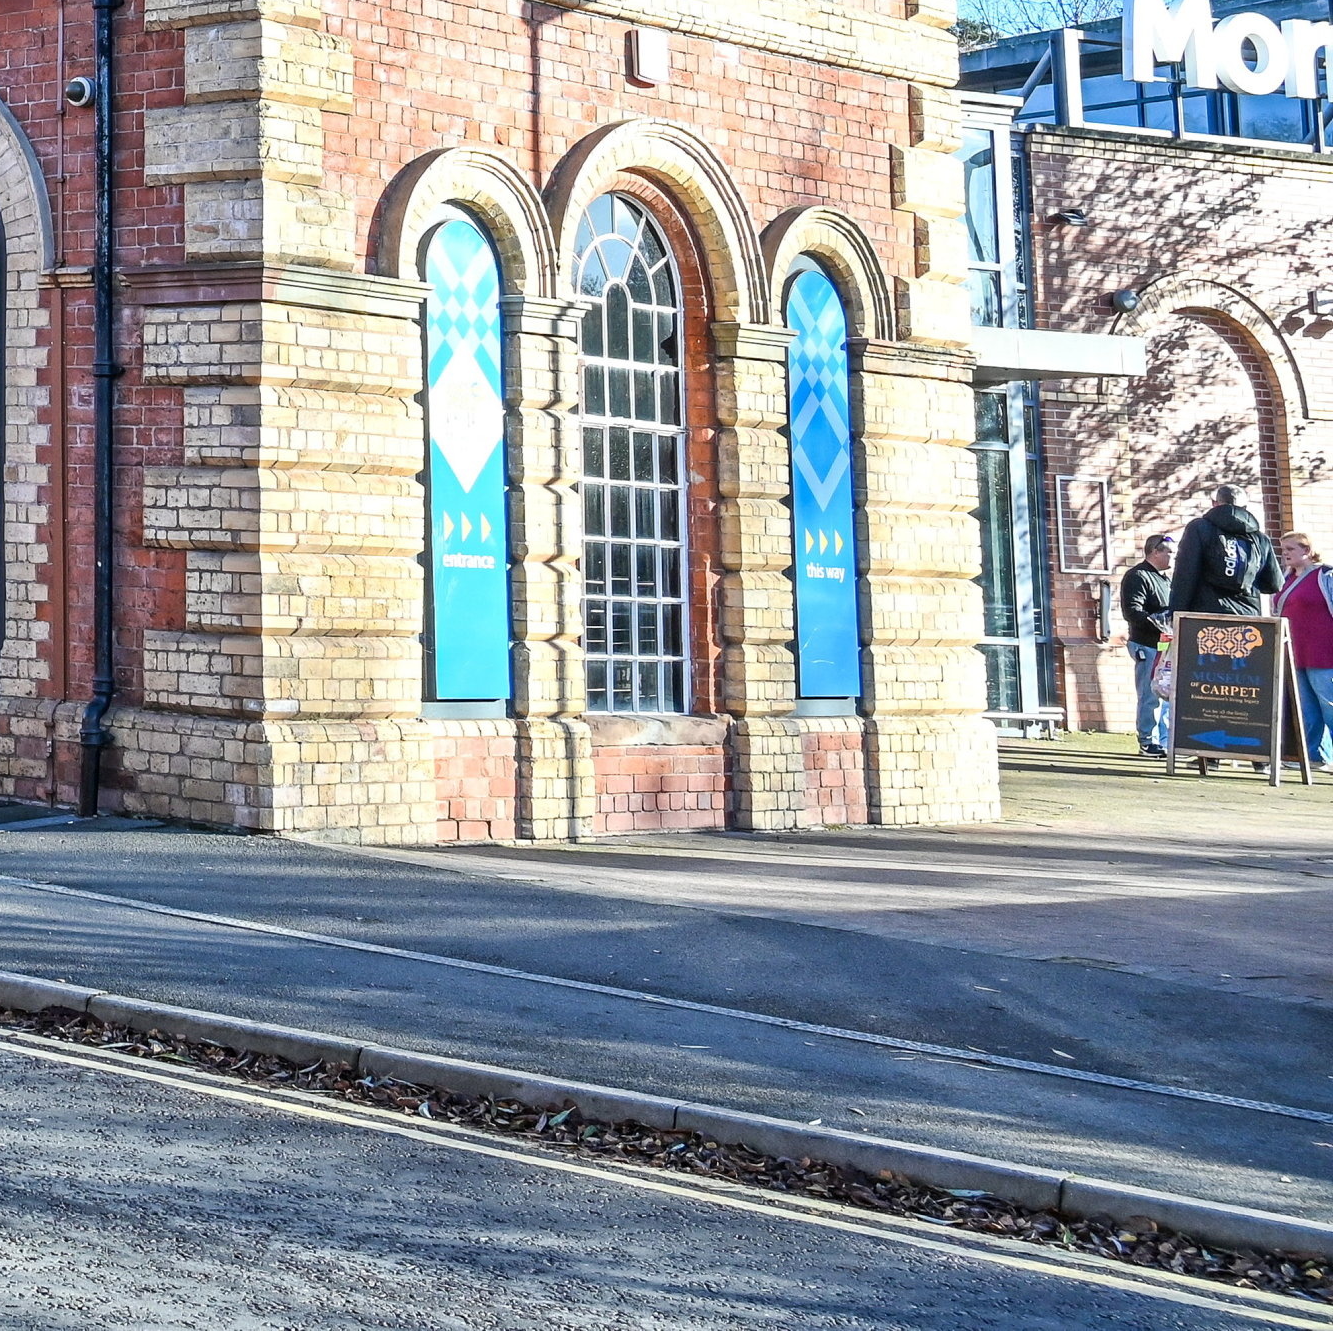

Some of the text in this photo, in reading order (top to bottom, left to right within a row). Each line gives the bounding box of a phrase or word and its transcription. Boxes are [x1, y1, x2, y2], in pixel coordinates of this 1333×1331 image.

[443, 553, 495, 569] entrance
[805, 562, 845, 583] this way
[1192, 671, 1261, 685] MUSEUM
[1201, 683, 1261, 697] CARPET
